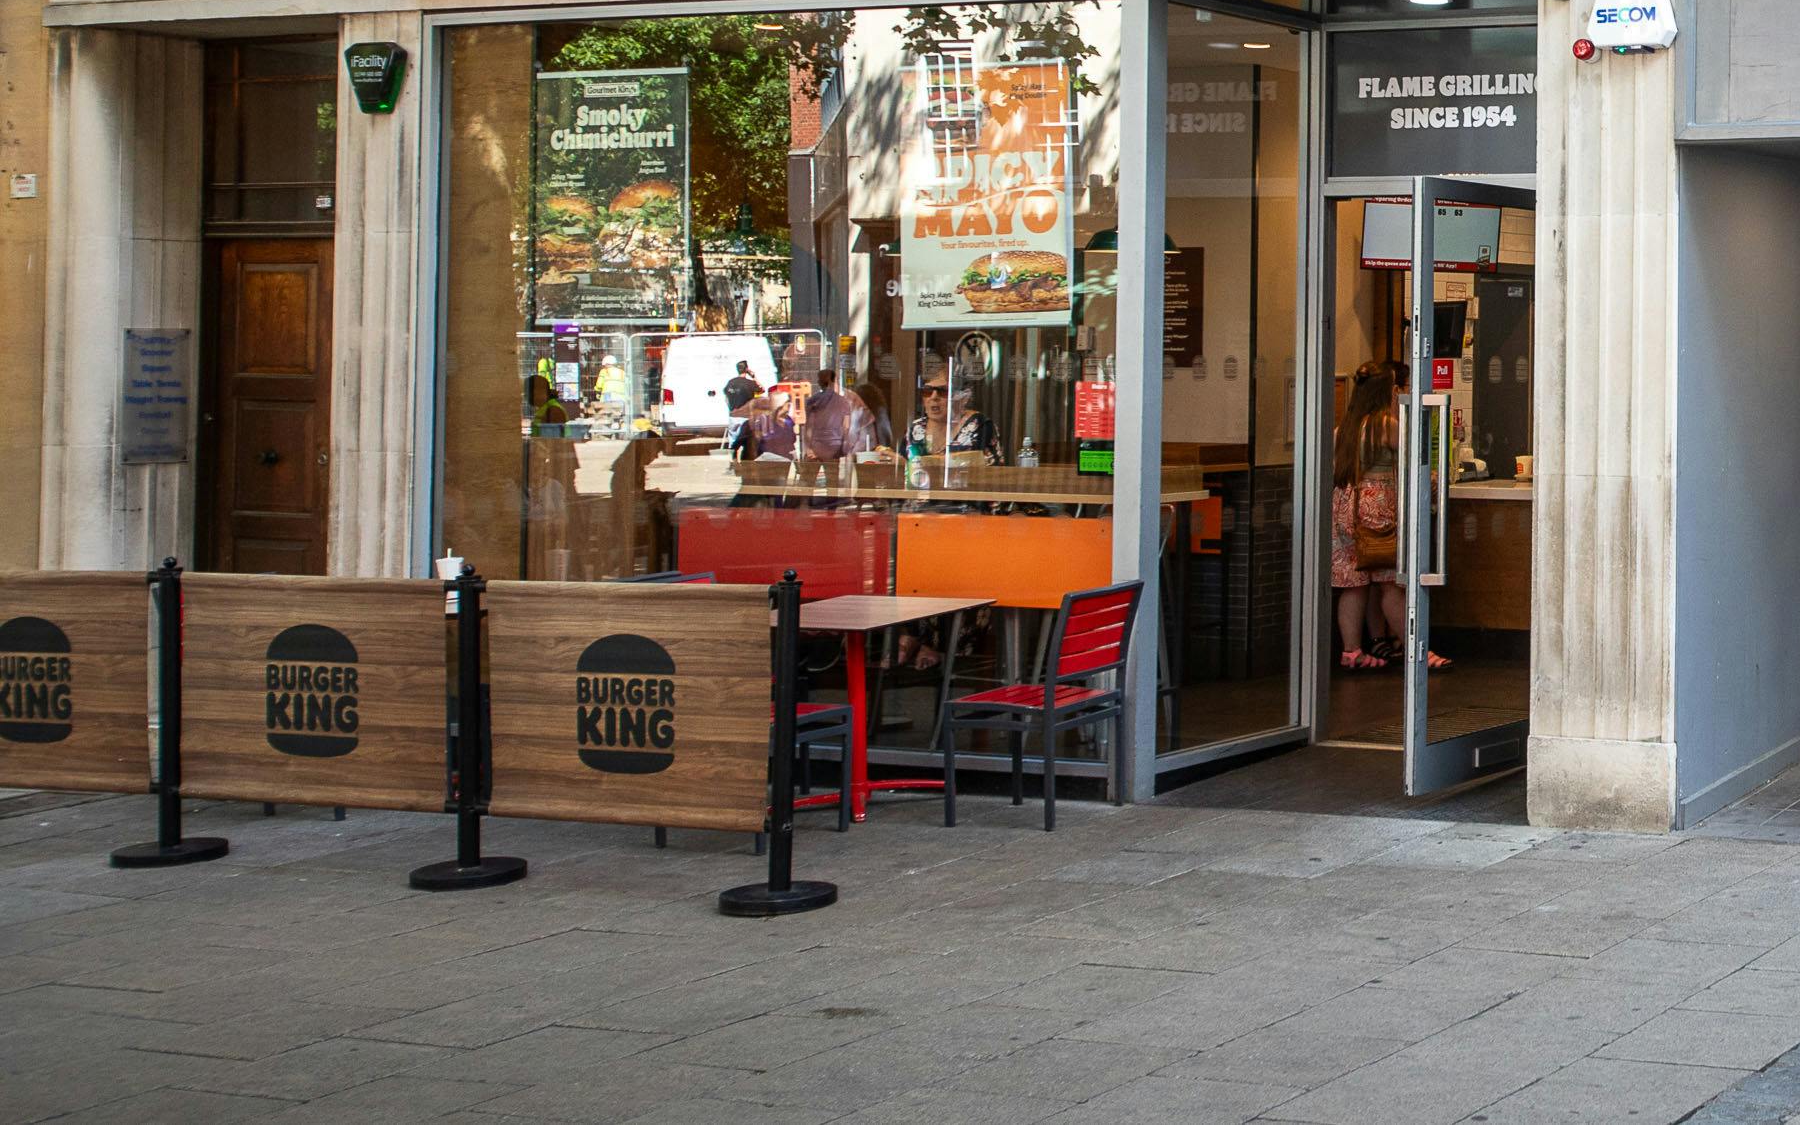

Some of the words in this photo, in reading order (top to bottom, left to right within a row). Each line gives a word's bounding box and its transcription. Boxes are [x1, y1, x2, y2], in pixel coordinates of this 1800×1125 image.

[1596, 6, 1656, 24] SECOM
[587, 85, 617, 95] Gourmet
[1358, 76, 1436, 99] FLAME
[577, 104, 647, 131] Smoky
[1390, 107, 1459, 129] SINCE
[1462, 105, 1517, 128] 1954
[550, 124, 675, 150] Chimichurri
[913, 189, 1060, 238] MAYO
[1438, 208, 1447, 216] 65
[1437, 365, 1448, 375] Pull
[267, 663, 359, 694] BURGER
[576, 676, 676, 707] BURGER
[267, 691, 359, 734] KING
[577, 705, 676, 749] KING
